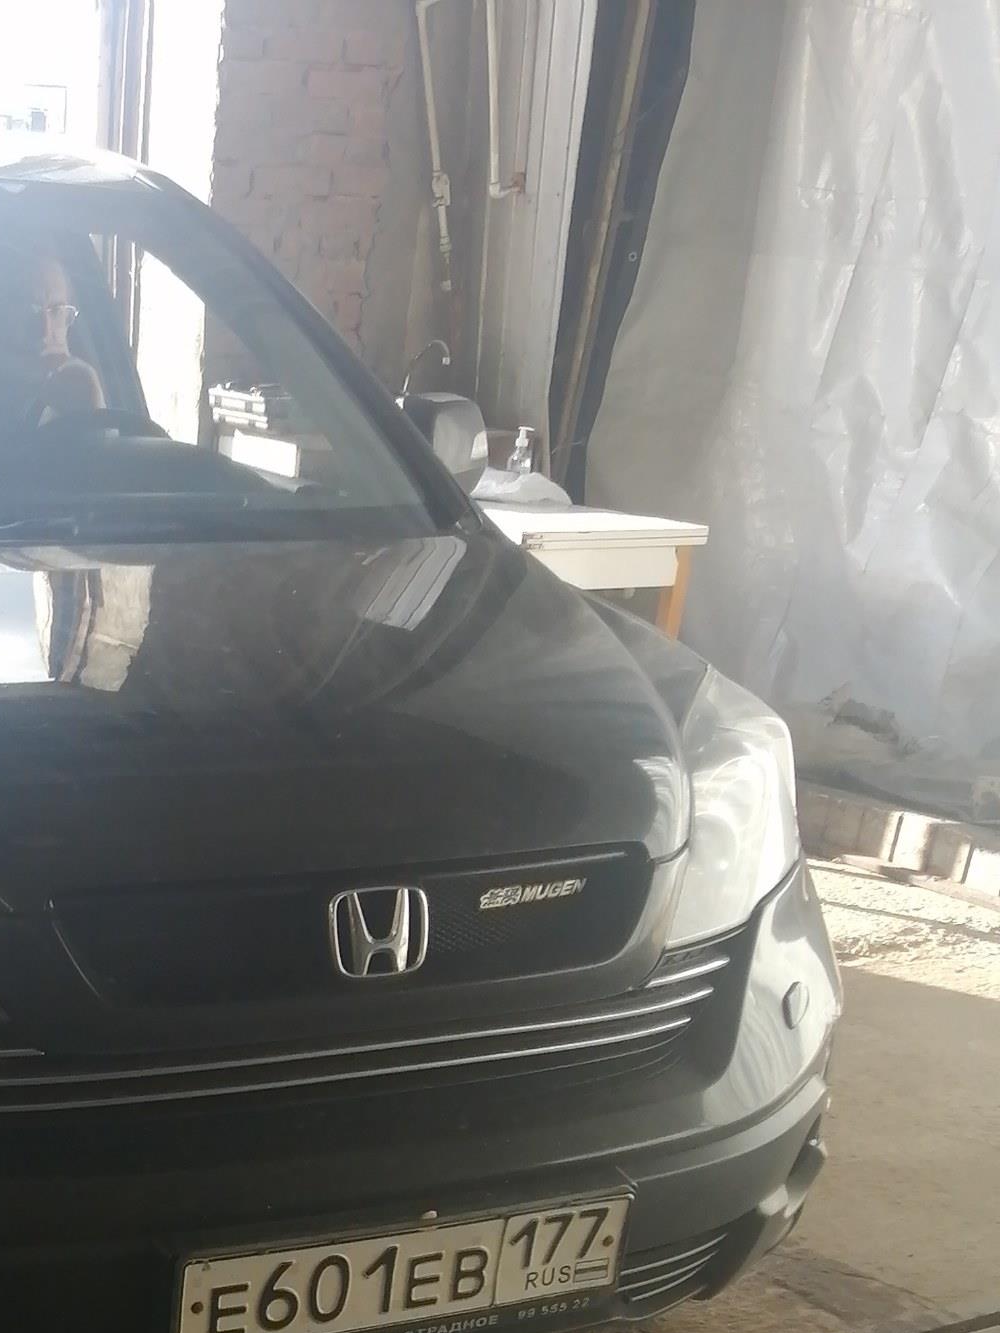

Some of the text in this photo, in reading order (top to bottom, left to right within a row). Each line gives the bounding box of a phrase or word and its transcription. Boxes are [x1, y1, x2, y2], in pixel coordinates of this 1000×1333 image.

[521, 878, 588, 902] MUGEN
[509, 1207, 608, 1269] 177
[525, 1265, 571, 1290] RUS
